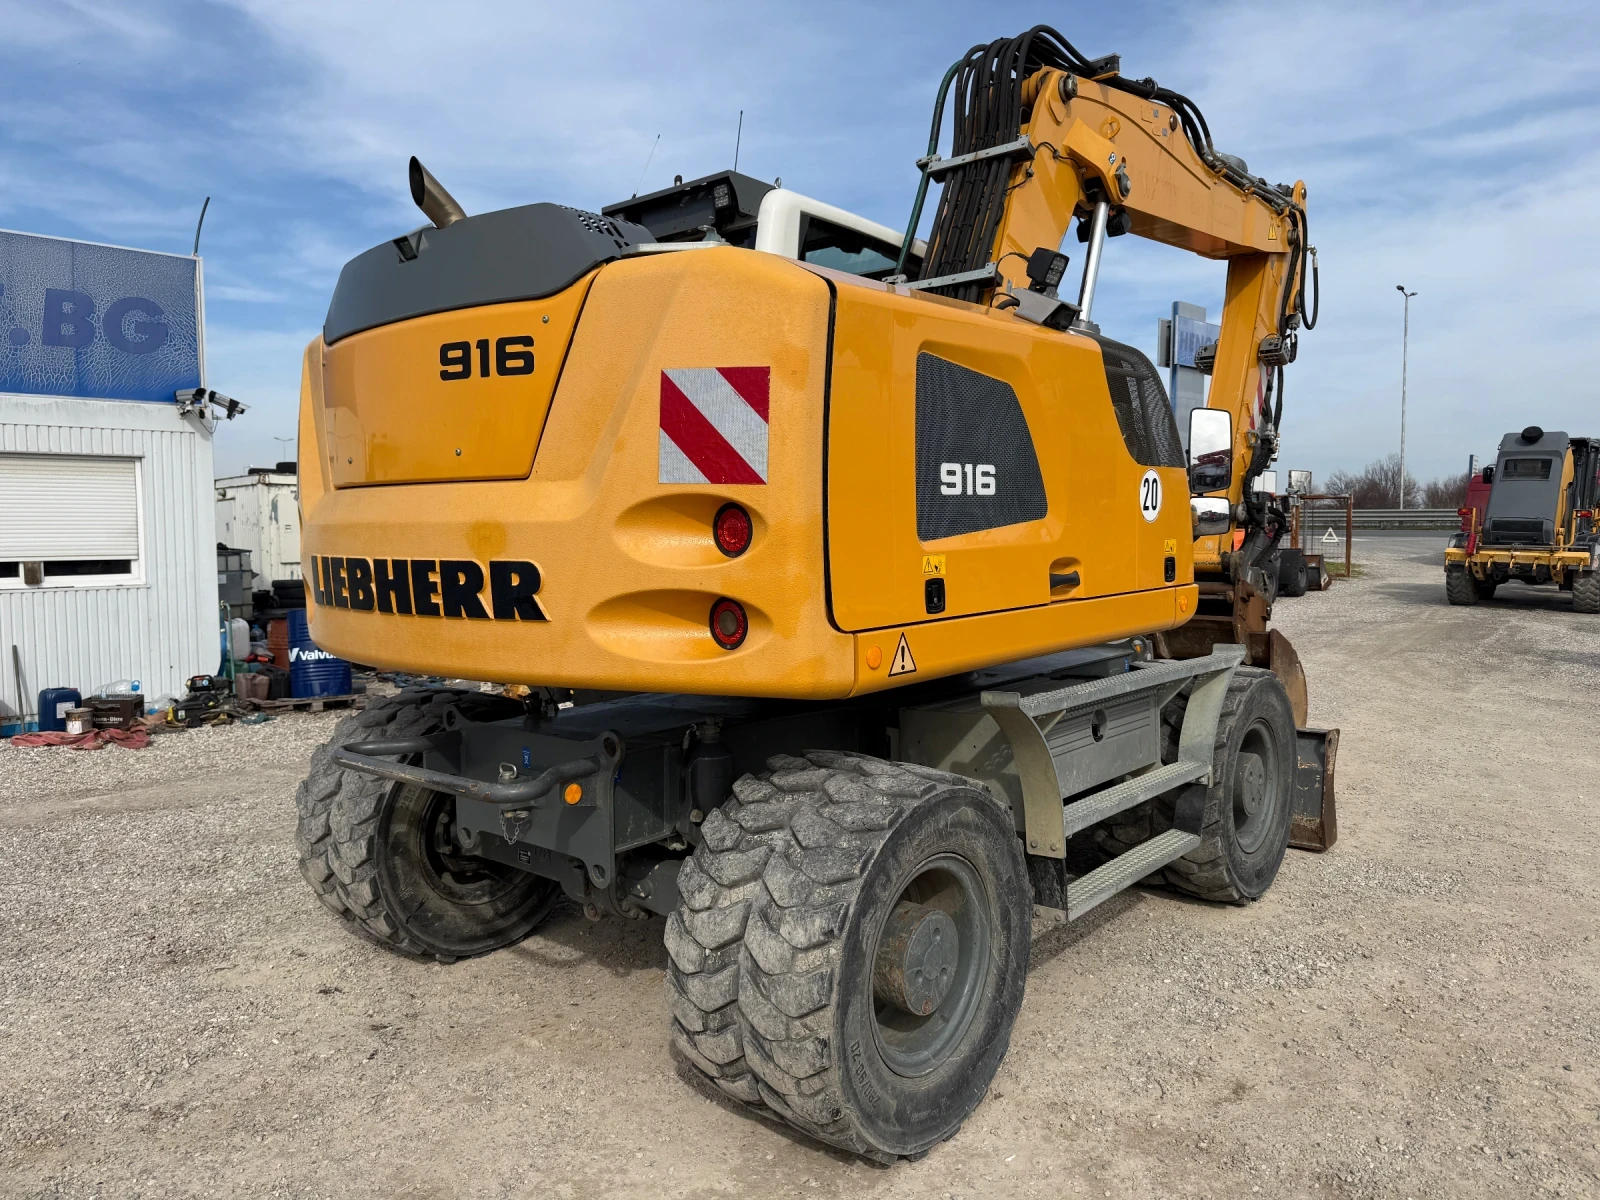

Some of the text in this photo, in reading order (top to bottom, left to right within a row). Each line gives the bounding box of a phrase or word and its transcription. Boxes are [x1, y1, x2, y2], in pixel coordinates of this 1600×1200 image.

[0, 283, 168, 354] .BG
[440, 335, 535, 381] 916
[940, 462, 996, 496] 916
[1143, 477, 1158, 511] 20
[311, 555, 551, 622] LIEBHERR
